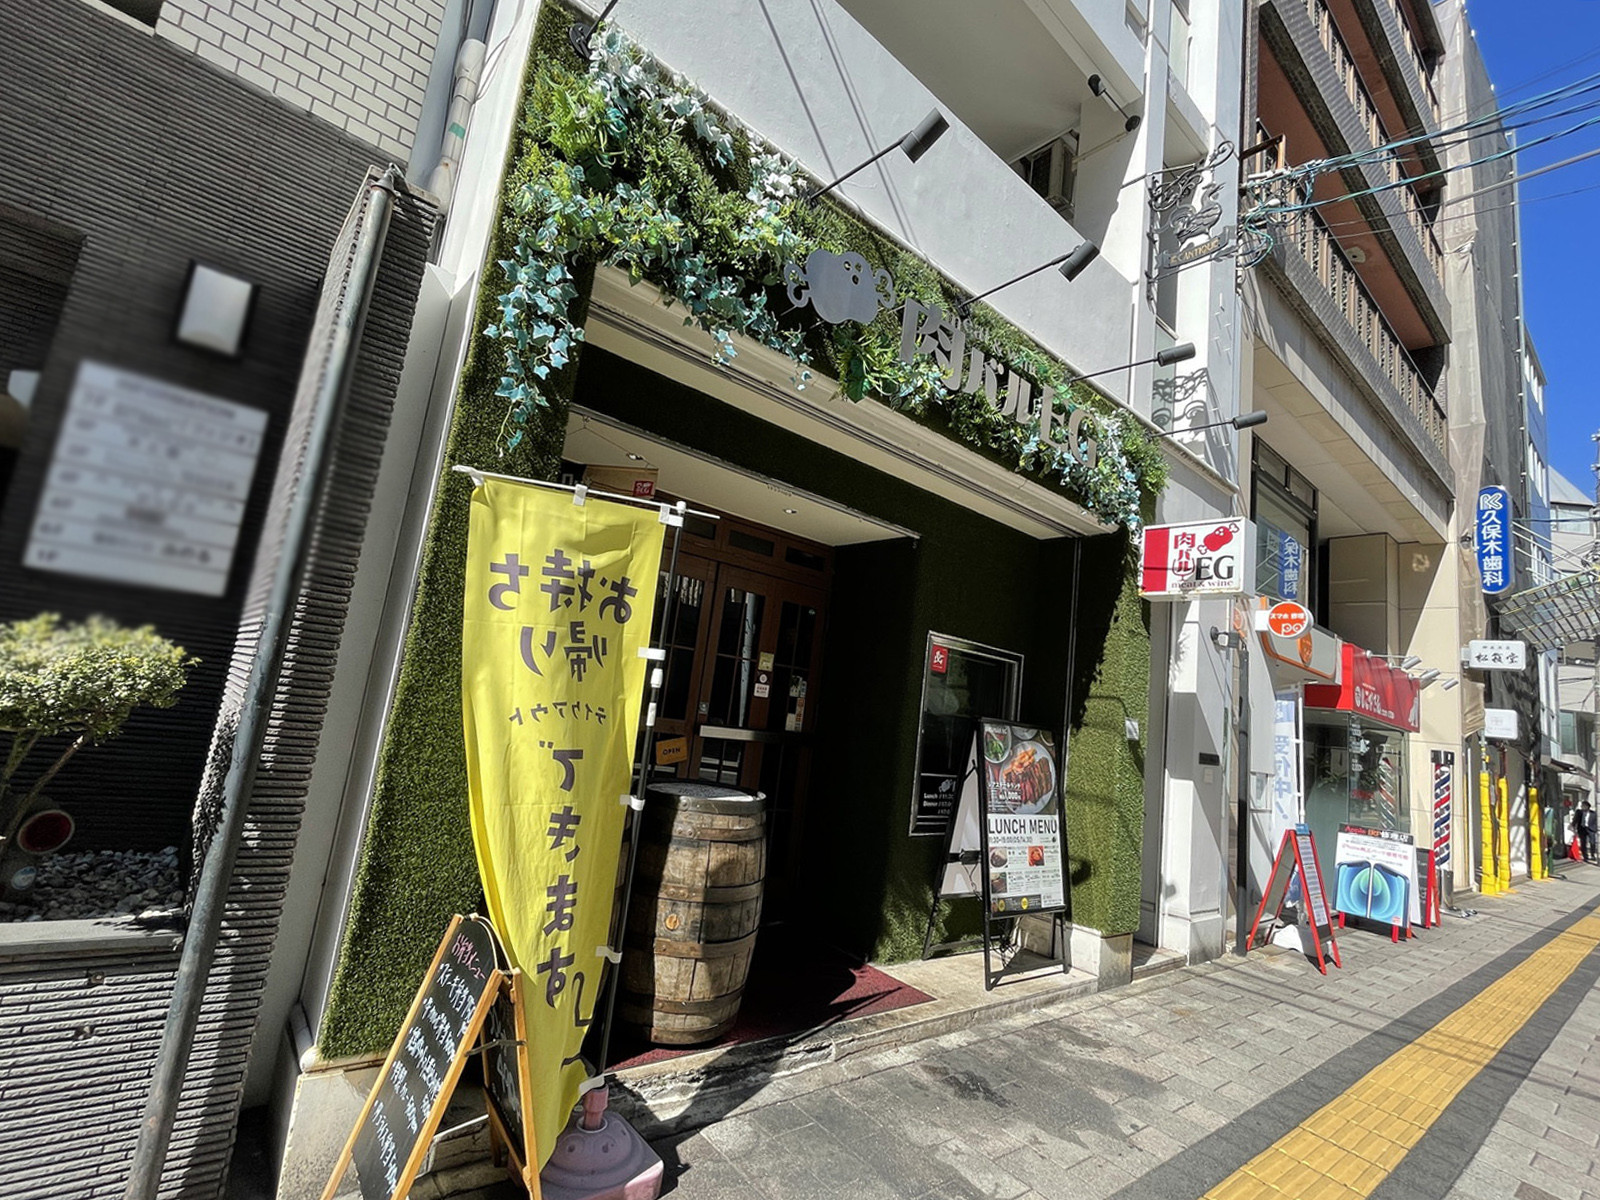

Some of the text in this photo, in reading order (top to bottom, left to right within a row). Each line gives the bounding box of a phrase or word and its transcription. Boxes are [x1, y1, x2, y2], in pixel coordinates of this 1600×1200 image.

[1173, 532, 1196, 572] 肉バル
[1481, 509, 1503, 587] 久保木歯科
[1195, 555, 1235, 581] EG
[988, 818, 1057, 834] LUNCH MENU
